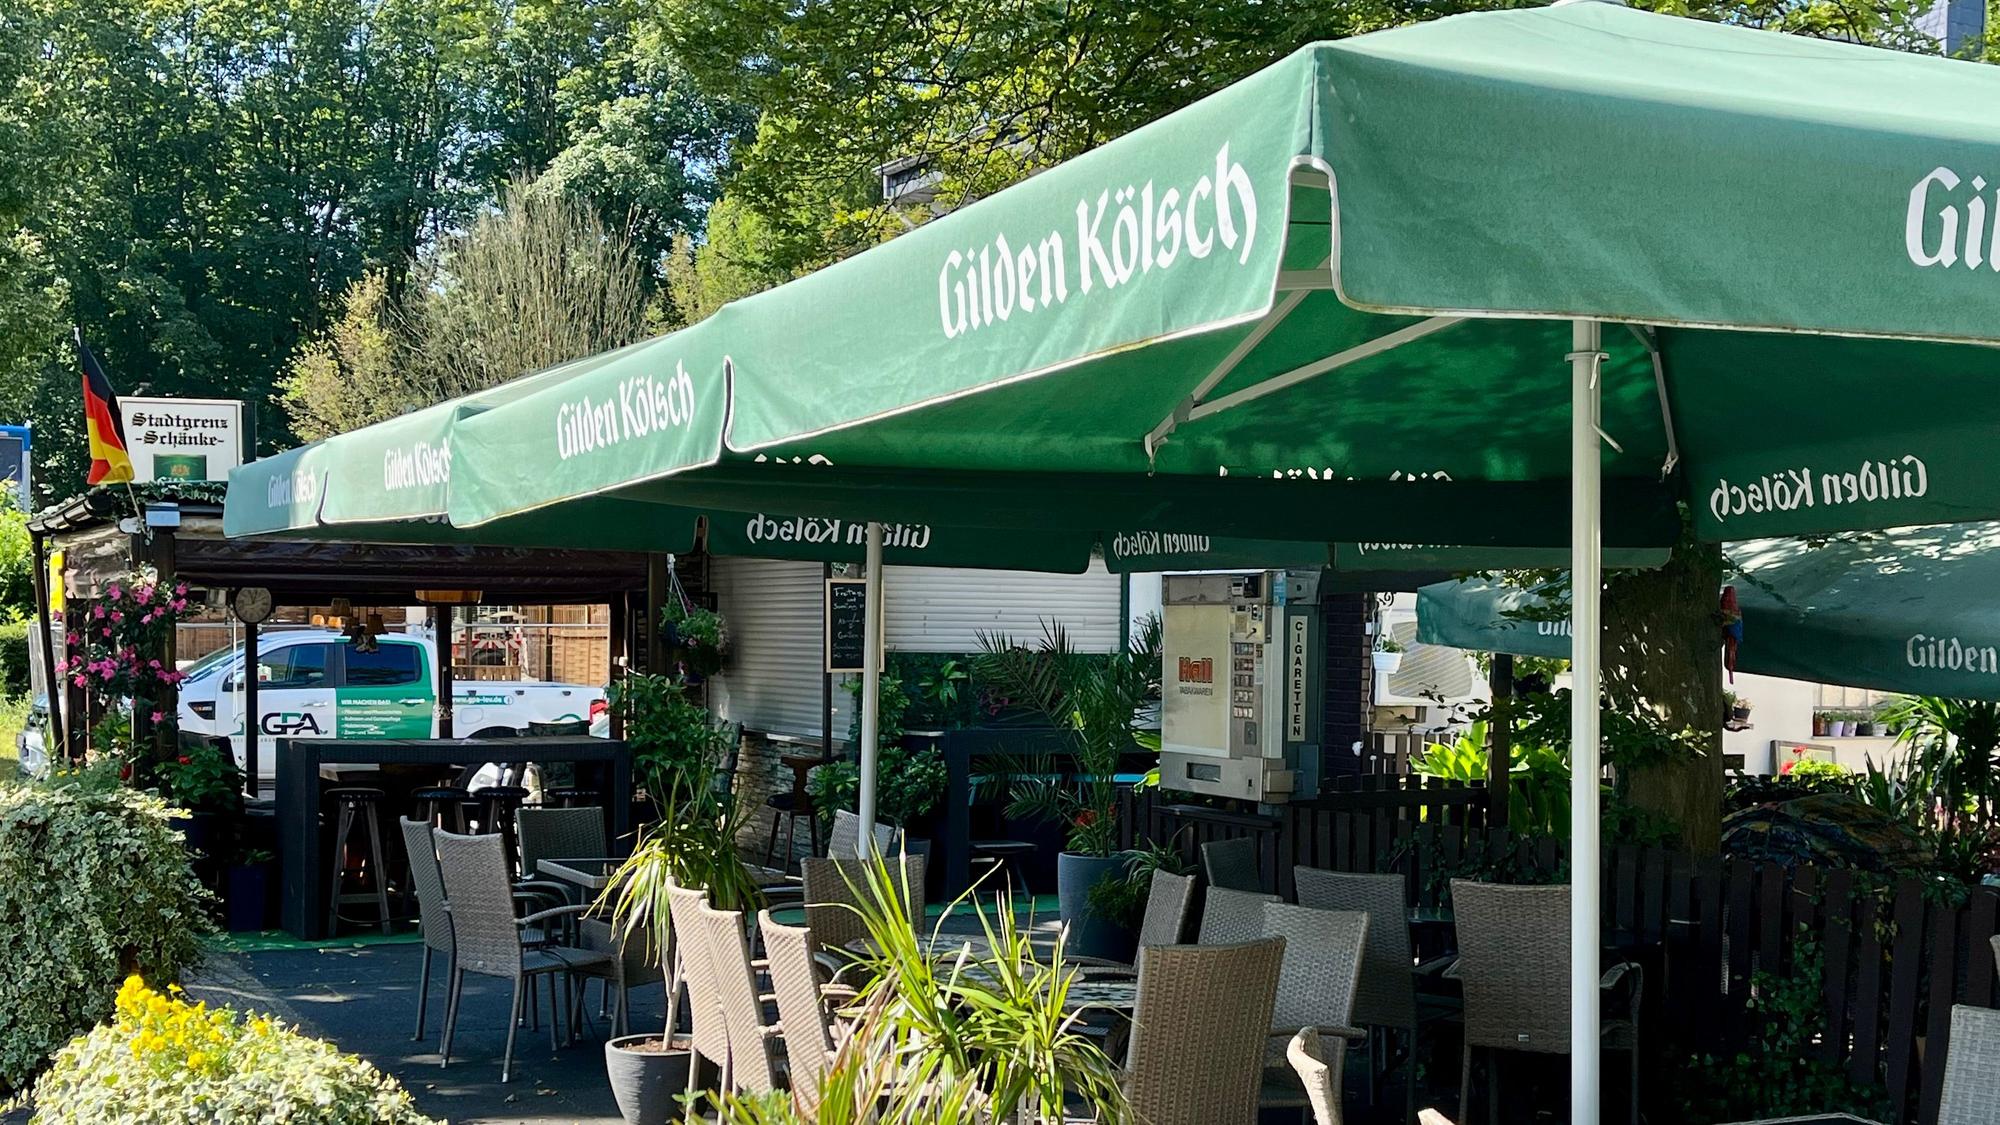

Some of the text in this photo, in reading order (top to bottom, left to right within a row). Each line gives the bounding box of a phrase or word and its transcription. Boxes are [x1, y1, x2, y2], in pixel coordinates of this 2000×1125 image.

[939, 140, 1257, 339] Gilden Kölsch
[132, 412, 228, 431] Stadtgrenz
[556, 358, 695, 460] Gilden Kölsch
[135, 430, 225, 448] -Schänke-
[267, 464, 317, 508] Gilden Kölsch
[384, 447, 416, 491] Gilden
[1906, 633, 1998, 674] Gilden
[1292, 621, 1305, 736] CIGARETTEN
[261, 712, 320, 735] GPA
